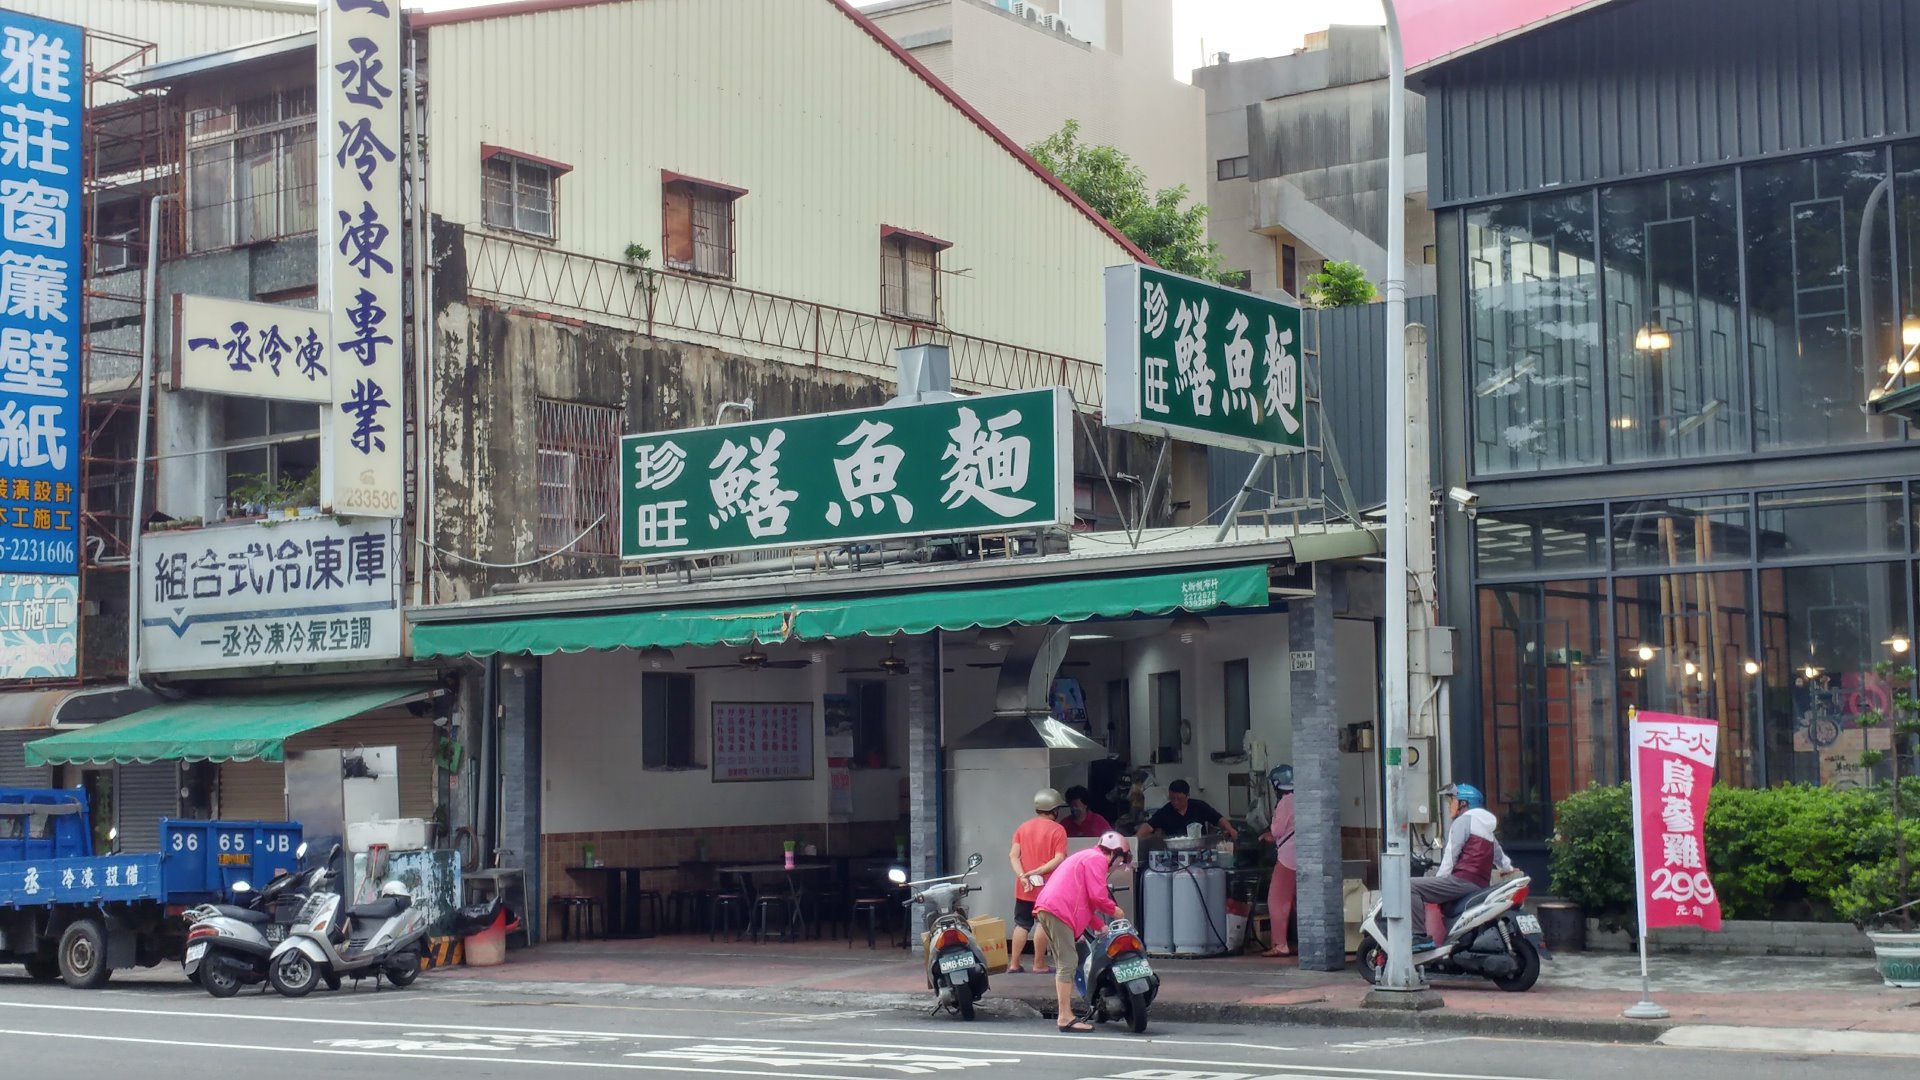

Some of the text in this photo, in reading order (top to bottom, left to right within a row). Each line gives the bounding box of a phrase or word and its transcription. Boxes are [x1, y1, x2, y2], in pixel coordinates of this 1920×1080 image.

[188, 321, 328, 382] 一丞冷凍
[1143, 281, 1170, 414] 珍旺
[1174, 297, 1300, 435] 鱔魚麵
[635, 440, 689, 548] 珍旺
[708, 406, 1037, 539] 鱔魚麵
[155, 531, 386, 603] 組合式冷凍庫
[200, 617, 371, 657] 一丞冷凍冷氣空調
[1643, 726, 1712, 756] 不上火
[1651, 868, 1715, 905] 299
